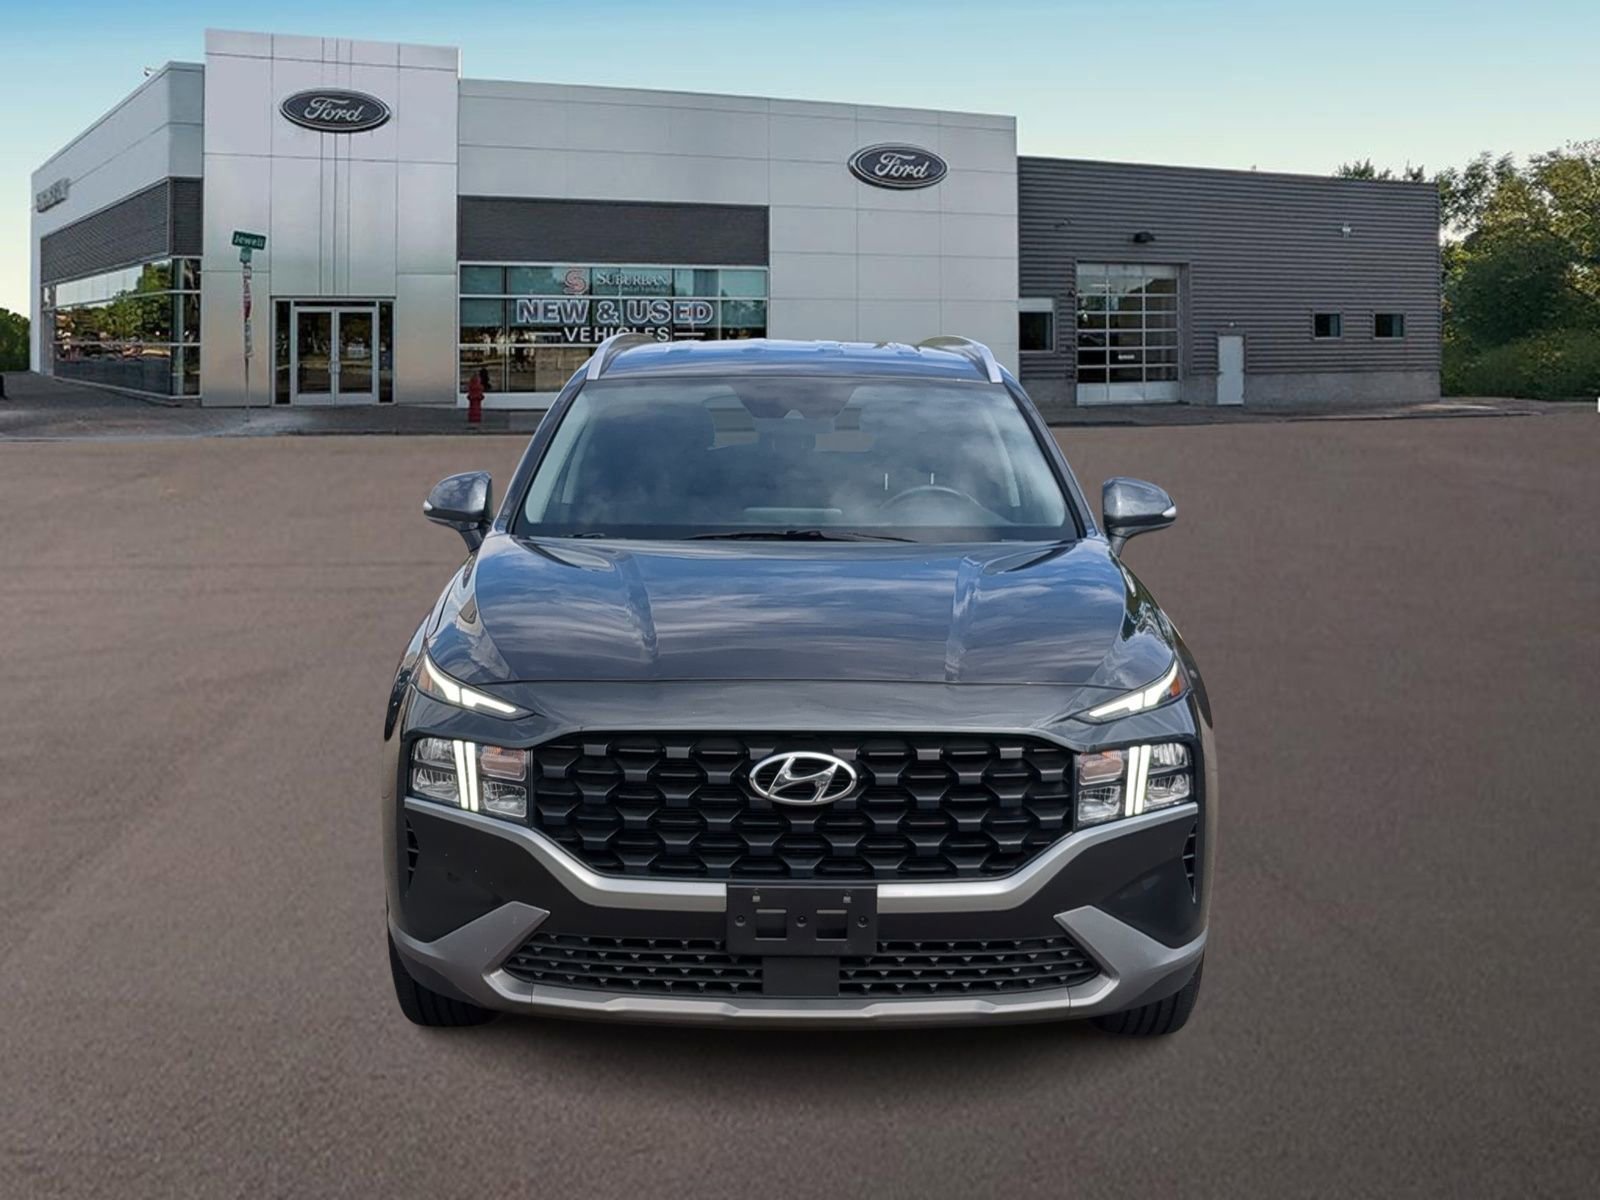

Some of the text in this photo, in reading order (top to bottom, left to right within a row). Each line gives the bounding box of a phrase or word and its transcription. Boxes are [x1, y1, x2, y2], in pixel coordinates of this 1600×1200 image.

[303, 96, 364, 122] Ford
[874, 152, 930, 178] Ford
[516, 300, 714, 324] NEW & USED
